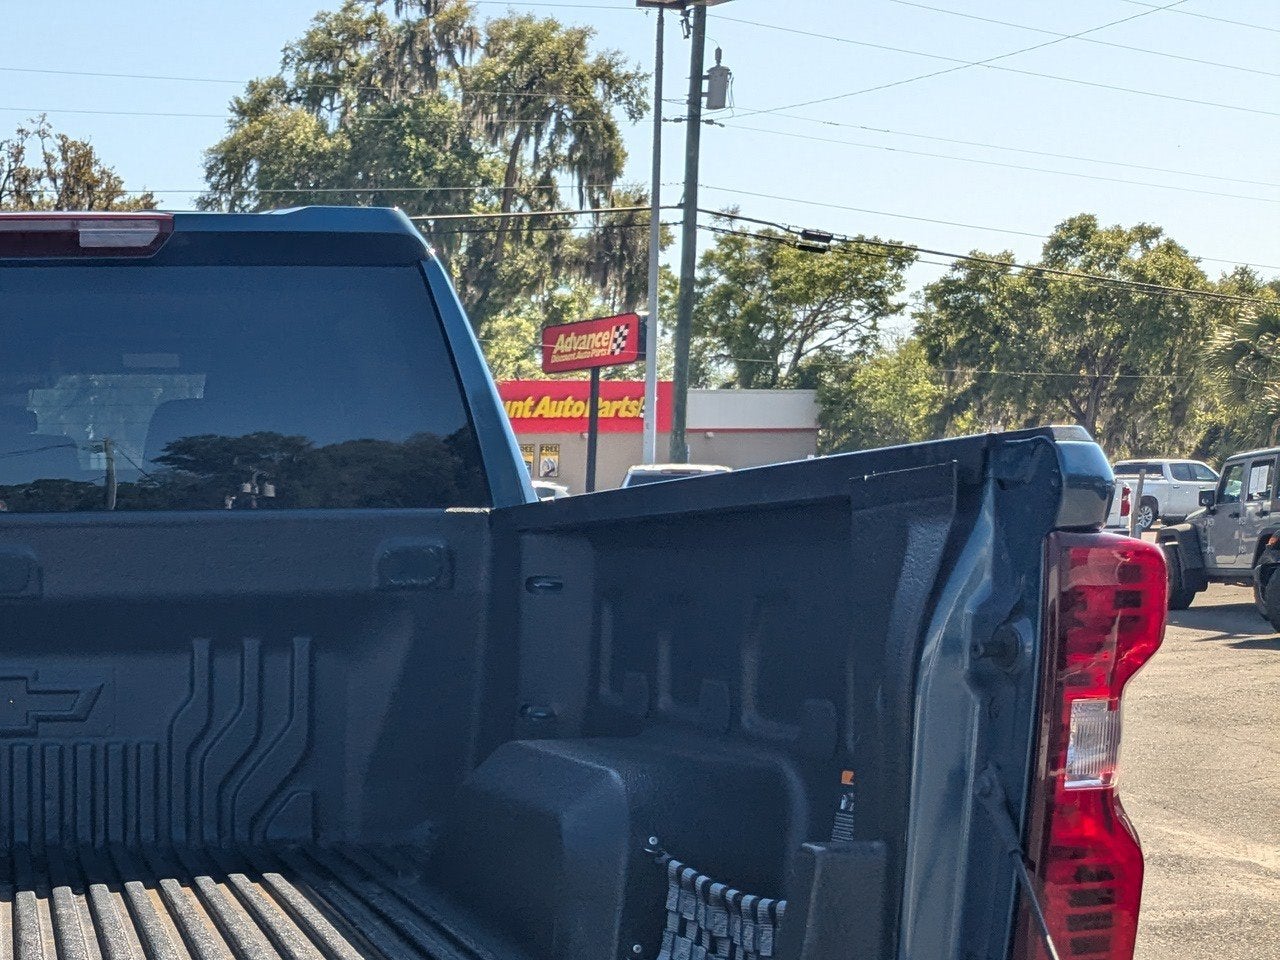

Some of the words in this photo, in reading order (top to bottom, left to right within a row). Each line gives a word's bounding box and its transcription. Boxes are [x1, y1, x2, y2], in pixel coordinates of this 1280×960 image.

[552, 330, 611, 355] Advance
[550, 352, 577, 364] Discount
[576, 350, 592, 360] Auto
[591, 347, 608, 358] Parts
[532, 395, 586, 418] Auto
